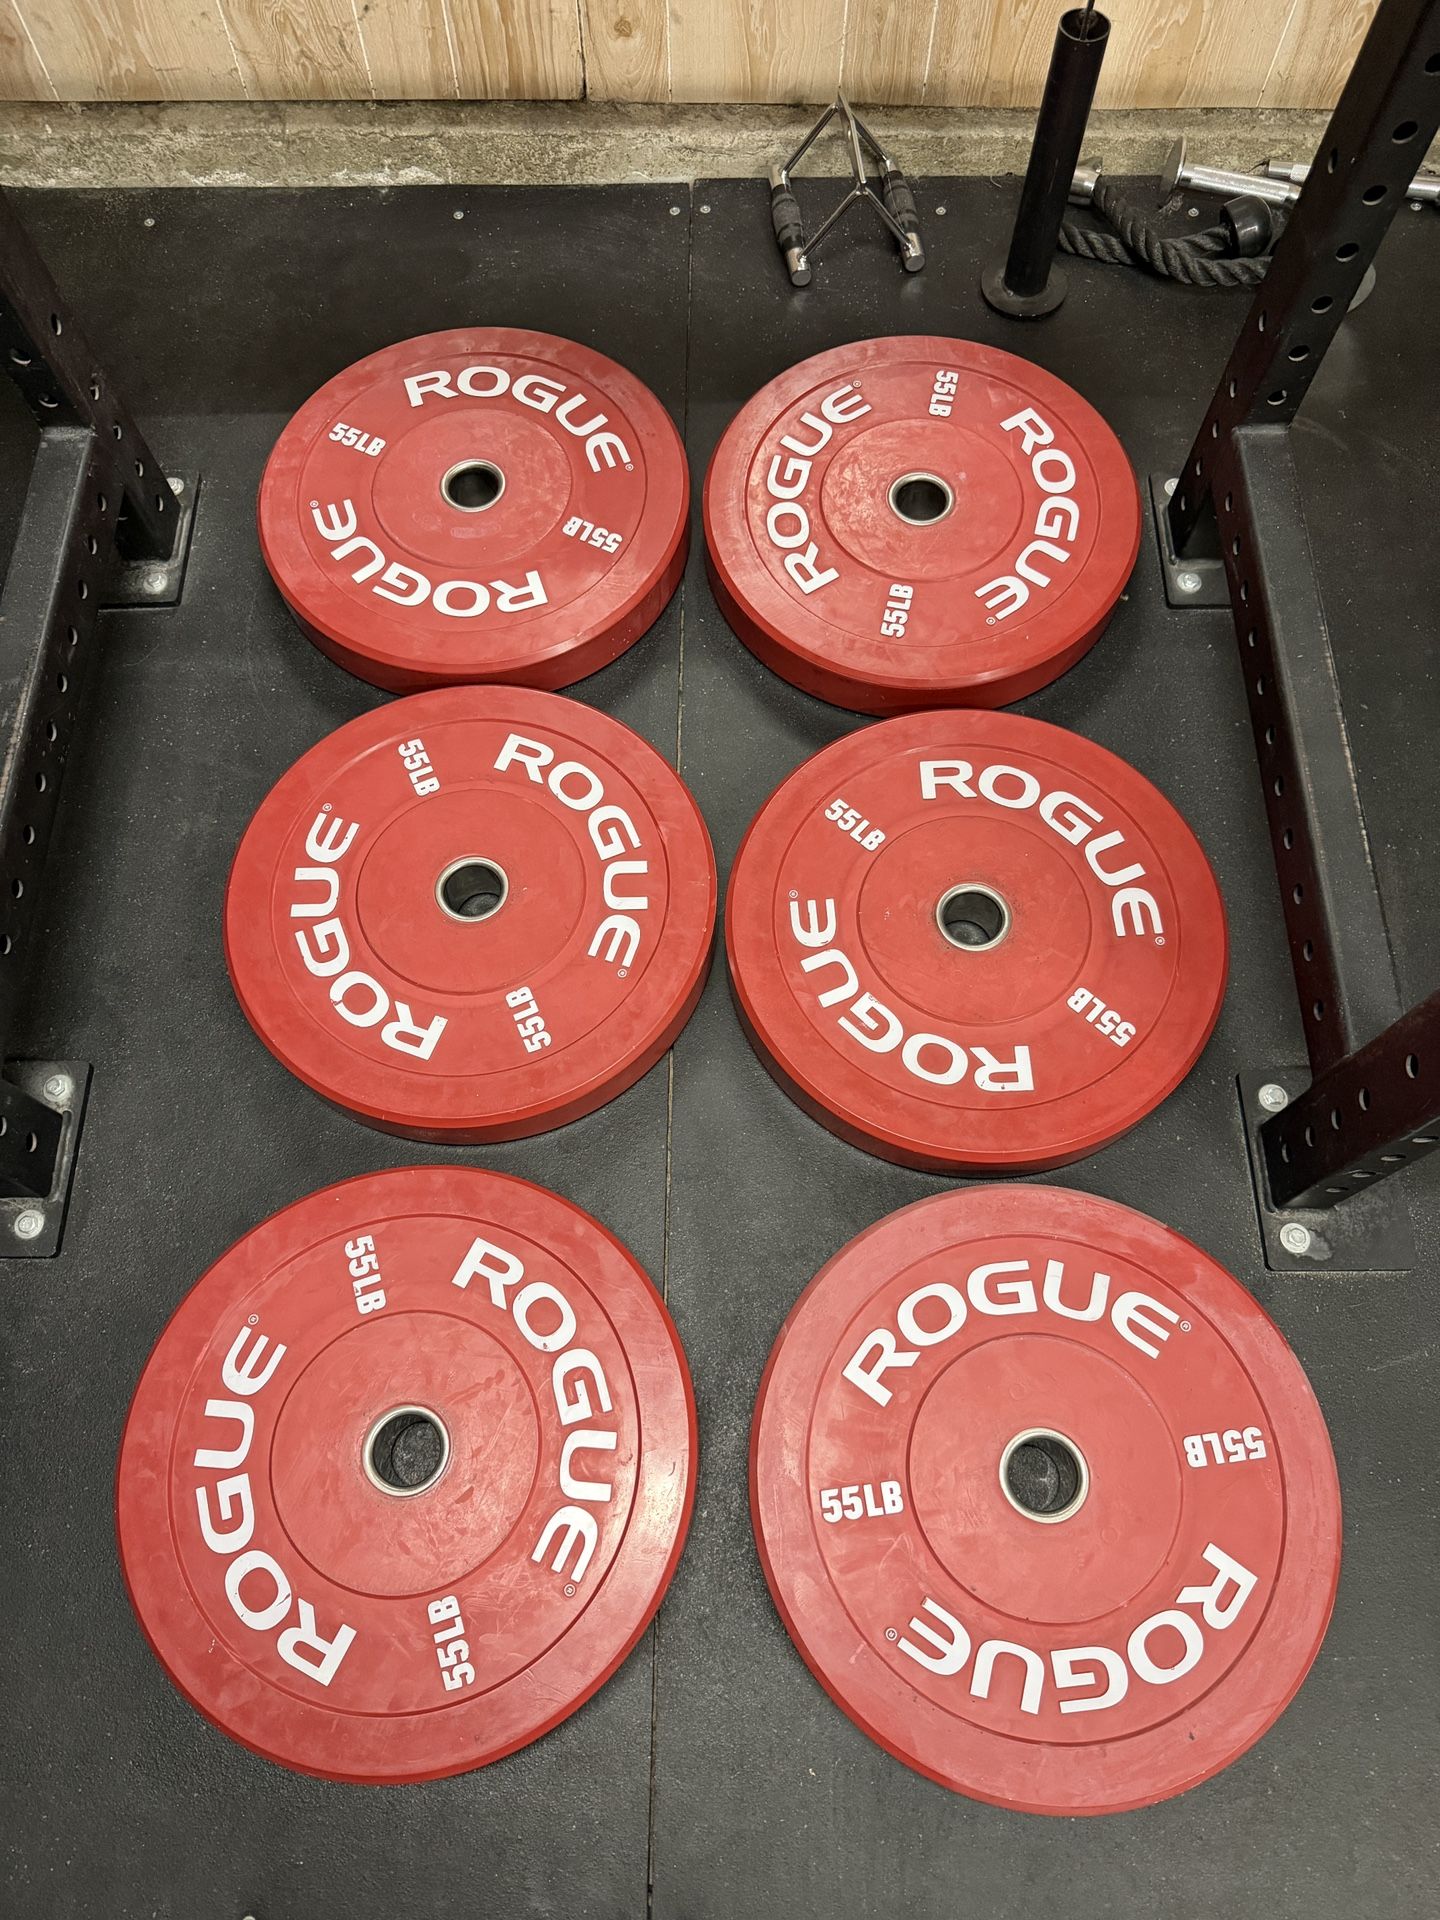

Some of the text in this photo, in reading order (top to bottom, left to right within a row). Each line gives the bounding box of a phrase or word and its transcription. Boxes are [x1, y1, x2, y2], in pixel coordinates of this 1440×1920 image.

[329, 422, 386, 456] 55LB
[404, 365, 632, 473] ROGUE
[929, 369, 959, 416] 55LB
[562, 516, 622, 553] 55LB
[767, 384, 873, 595] ROGUE
[975, 407, 1080, 620] ROGUE
[312, 499, 548, 617] ROGUE
[880, 584, 913, 637] 55LB
[398, 739, 440, 796] 55LB
[494, 733, 648, 968] ROGUE
[825, 799, 886, 851] 55LB
[920, 760, 1163, 936] ROGUE
[290, 813, 448, 1060] ROGUE
[506, 986, 551, 1053] 55LB
[790, 898, 1034, 1092] ROGUE
[1067, 988, 1136, 1047] 55LB
[345, 1235, 386, 1314] 55LB
[842, 1259, 1180, 1407] ROGUE
[452, 1237, 618, 1584] ROGUE
[1184, 1427, 1267, 1468] 55LB
[193, 1326, 357, 1686] ROGUE
[820, 1480, 905, 1524] 55LB
[428, 1595, 475, 1691] 55LB
[896, 1543, 1259, 1715] ROGUE
